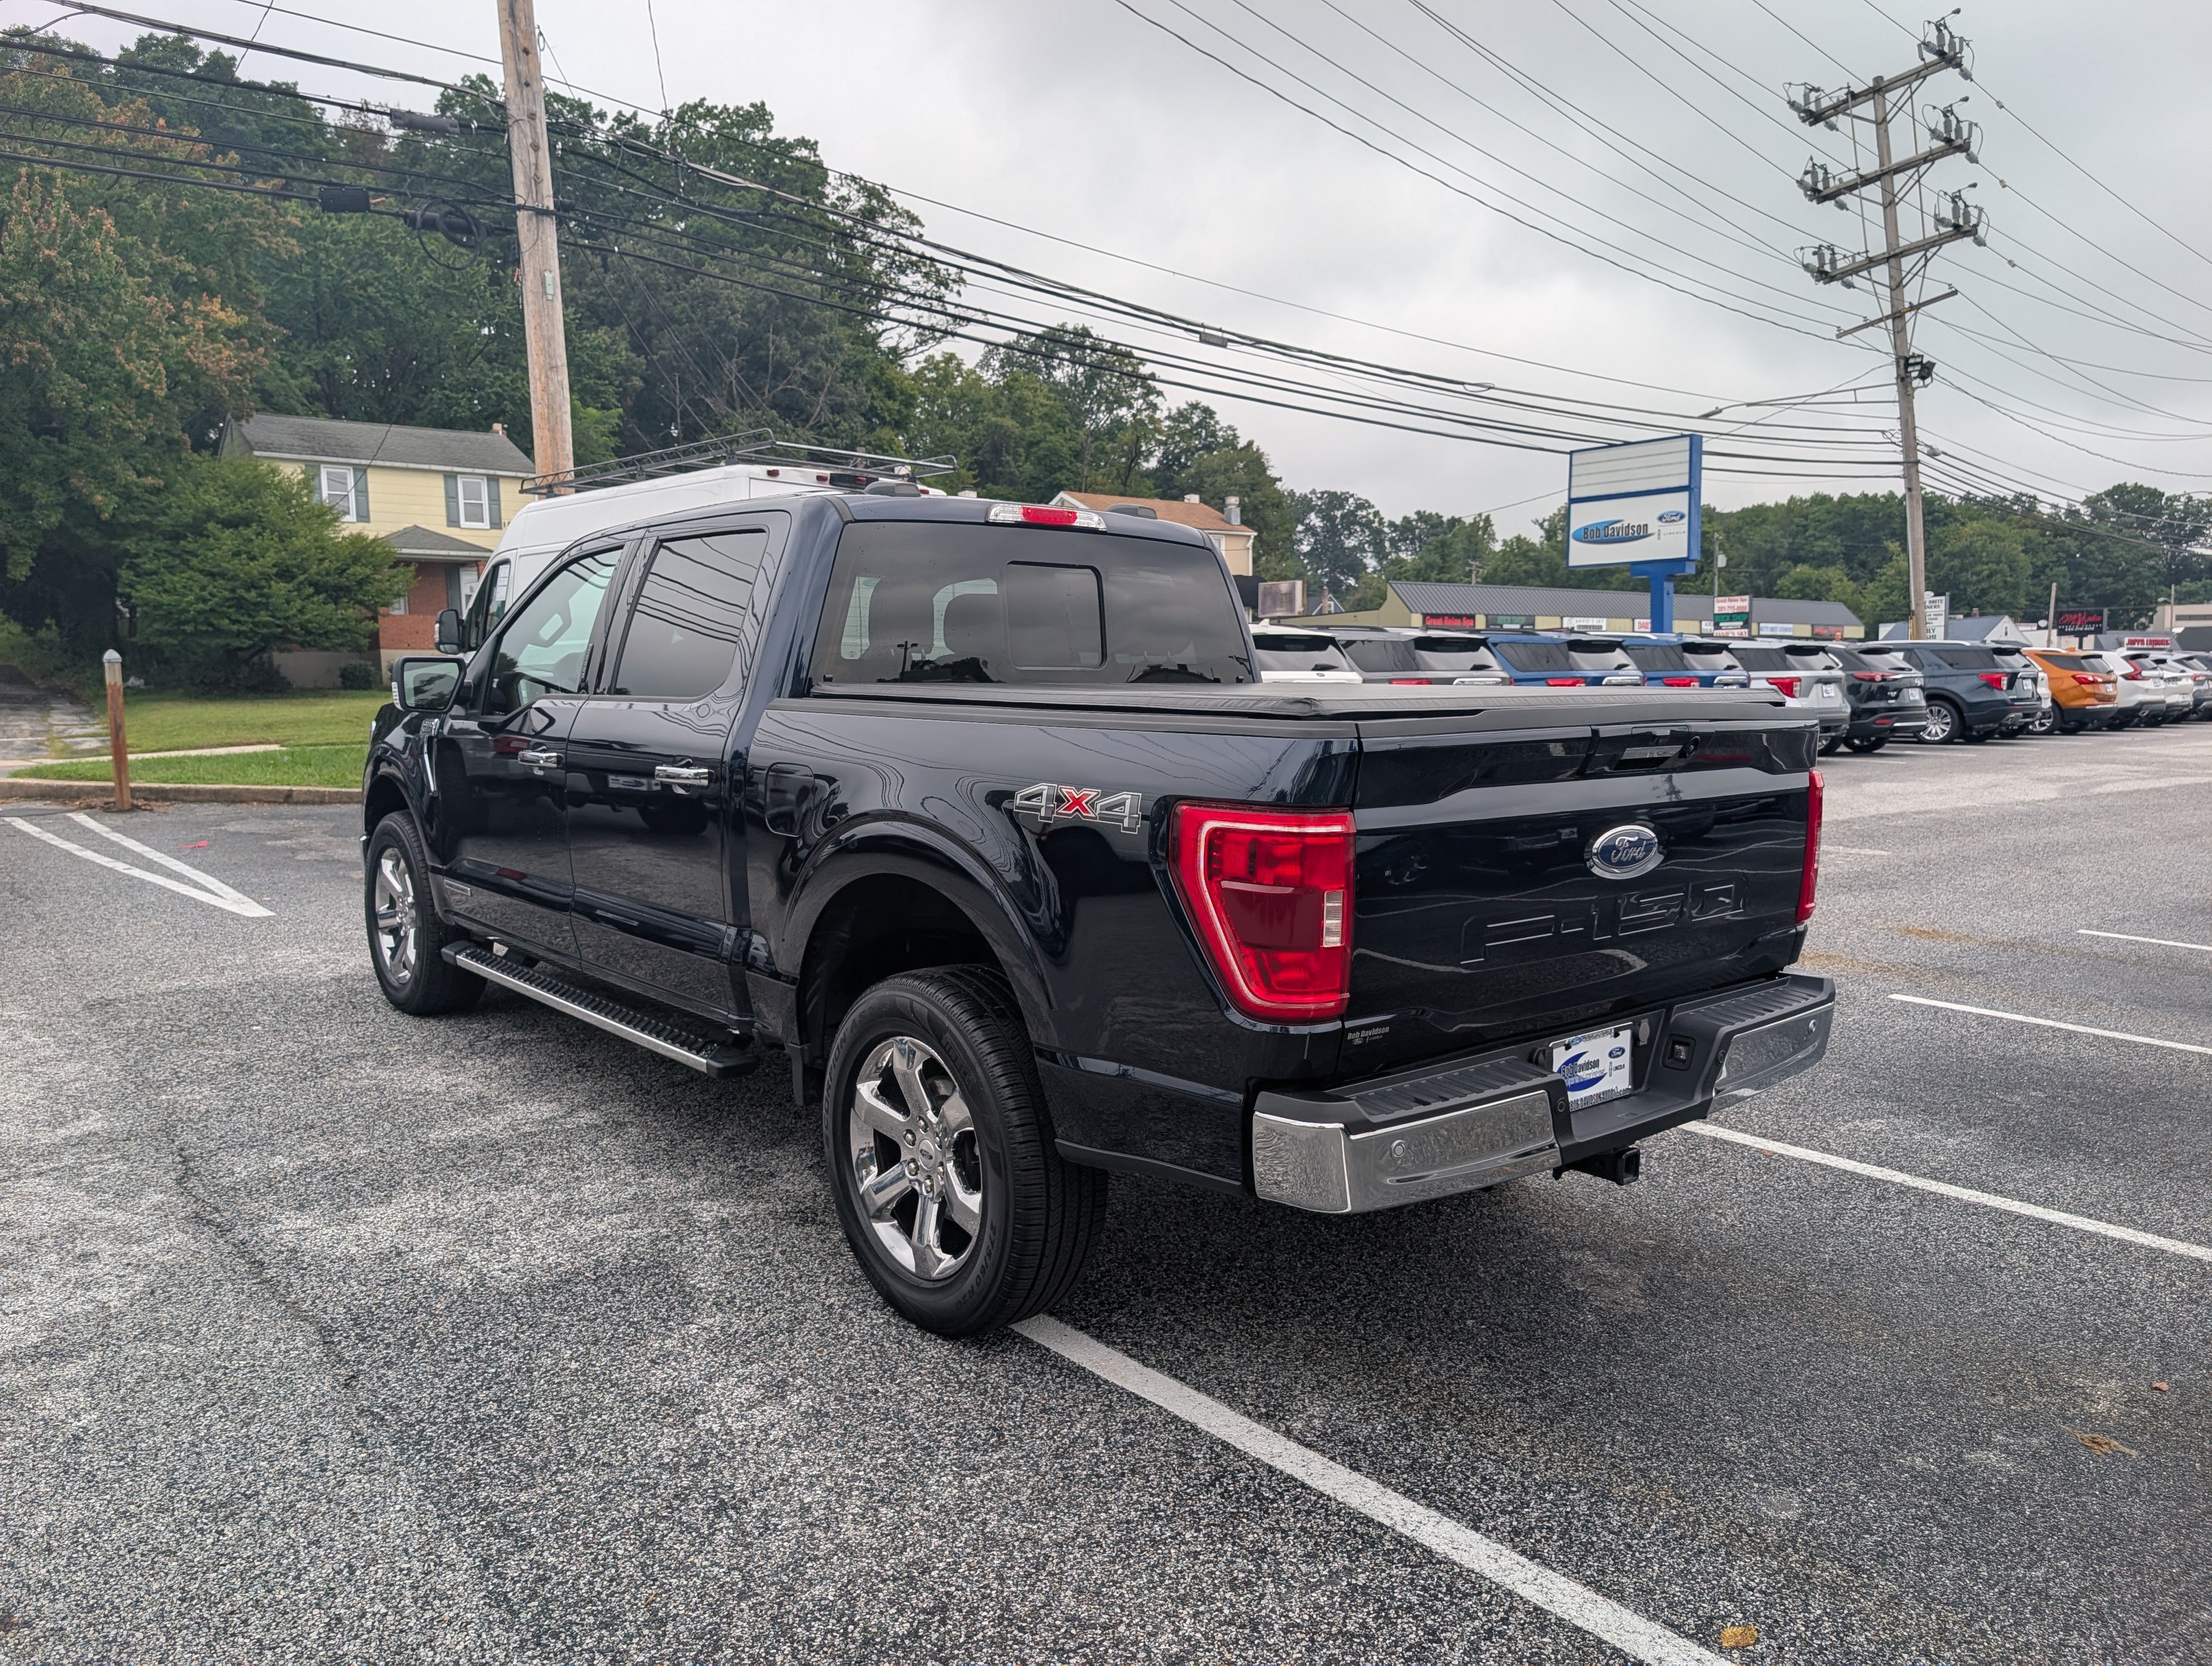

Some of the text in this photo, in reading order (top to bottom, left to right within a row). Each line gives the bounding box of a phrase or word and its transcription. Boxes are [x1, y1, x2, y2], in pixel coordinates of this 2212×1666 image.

[1661, 512, 1681, 522] Ford
[1583, 523, 1649, 540] Bob Davidson
[1426, 616, 1474, 627] Great Relax Spa
[1611, 836, 1645, 863] Ford
[1461, 874, 1748, 964] F-150
[1347, 1027, 1390, 1040] Bob Davidson
[1611, 1048, 1623, 1057] Ford
[1562, 1059, 1600, 1077] Bob Davidson
